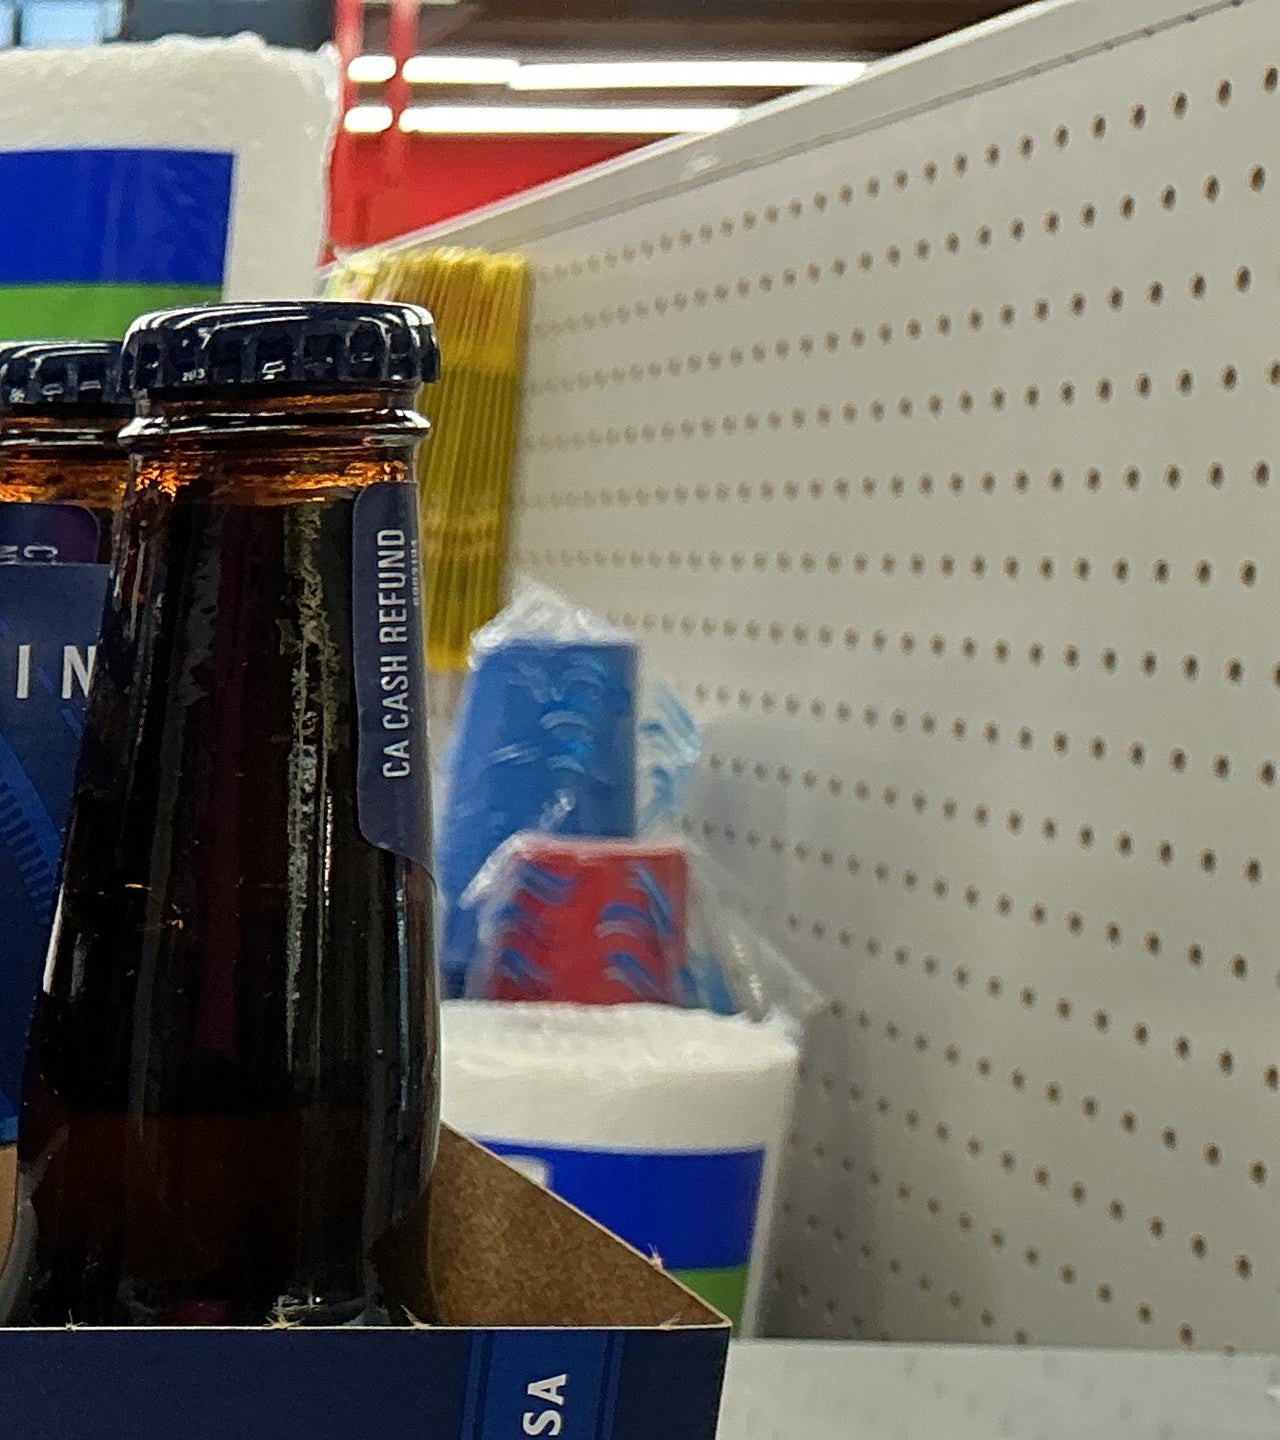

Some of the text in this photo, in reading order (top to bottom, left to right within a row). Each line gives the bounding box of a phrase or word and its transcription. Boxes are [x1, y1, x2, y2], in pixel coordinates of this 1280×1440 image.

[377, 529, 410, 779] CA CASH REFUND
